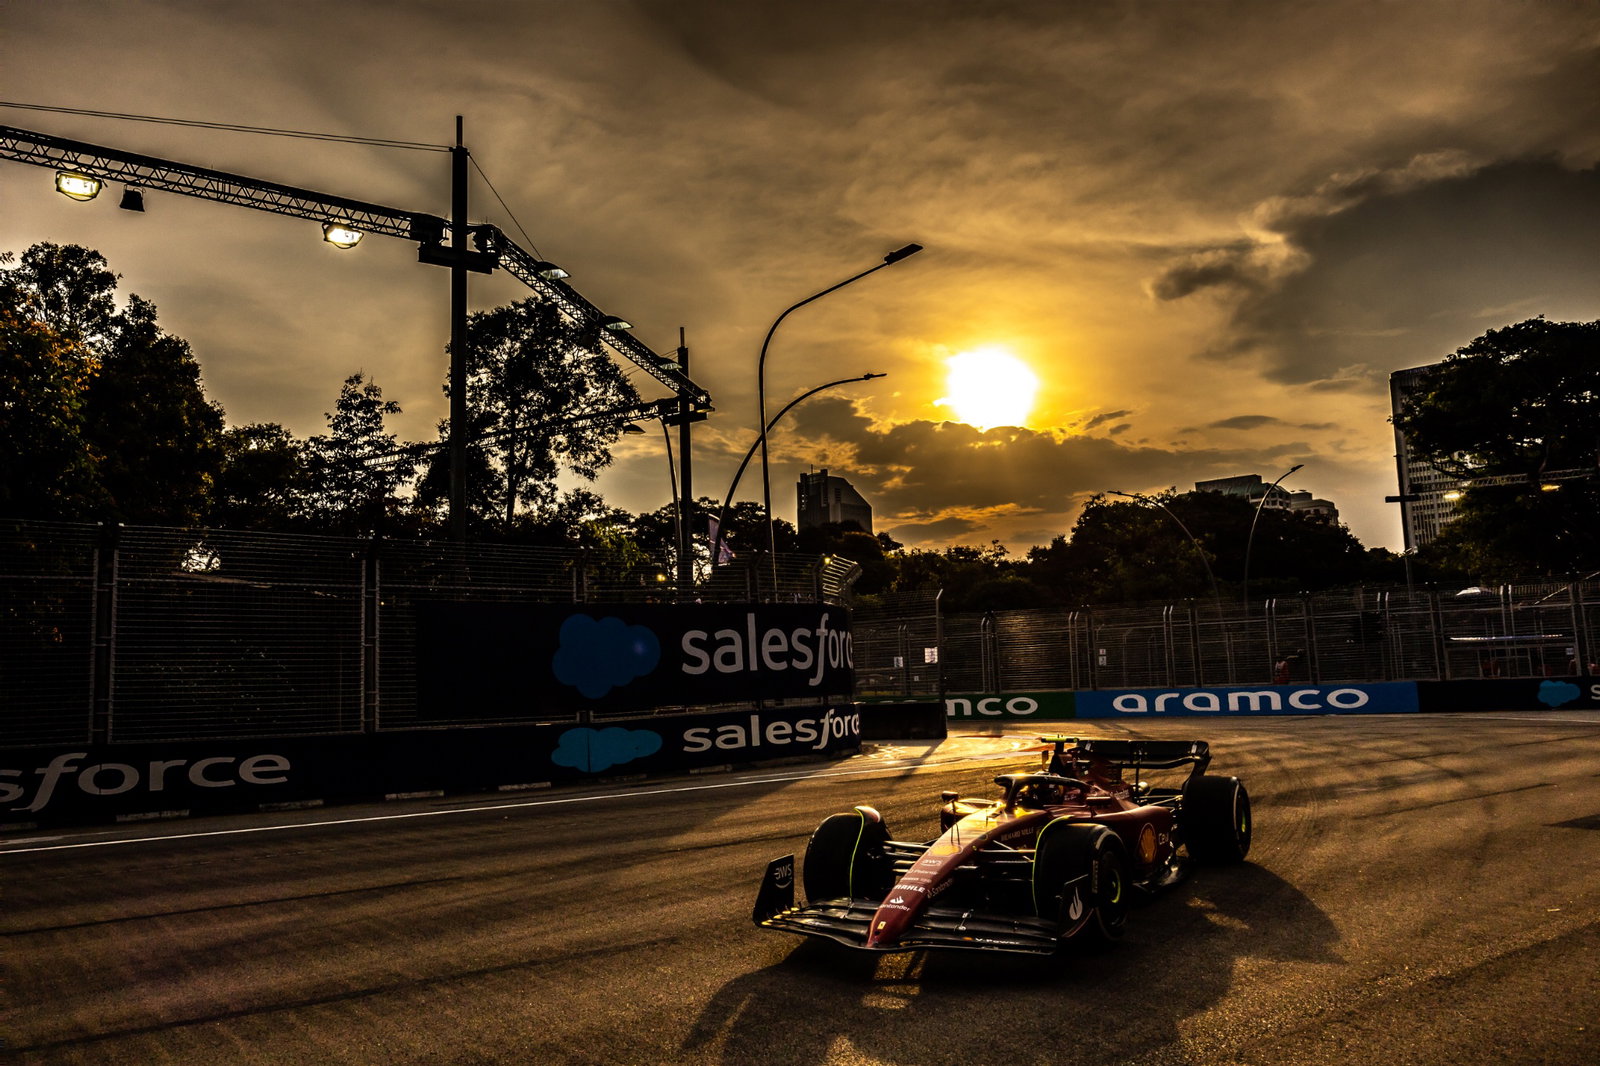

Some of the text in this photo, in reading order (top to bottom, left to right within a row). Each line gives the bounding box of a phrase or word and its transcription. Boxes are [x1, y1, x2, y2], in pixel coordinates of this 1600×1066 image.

[681, 611, 854, 687] salesforc
[1112, 688, 1370, 713] aramco
[682, 708, 860, 753] salesforc
